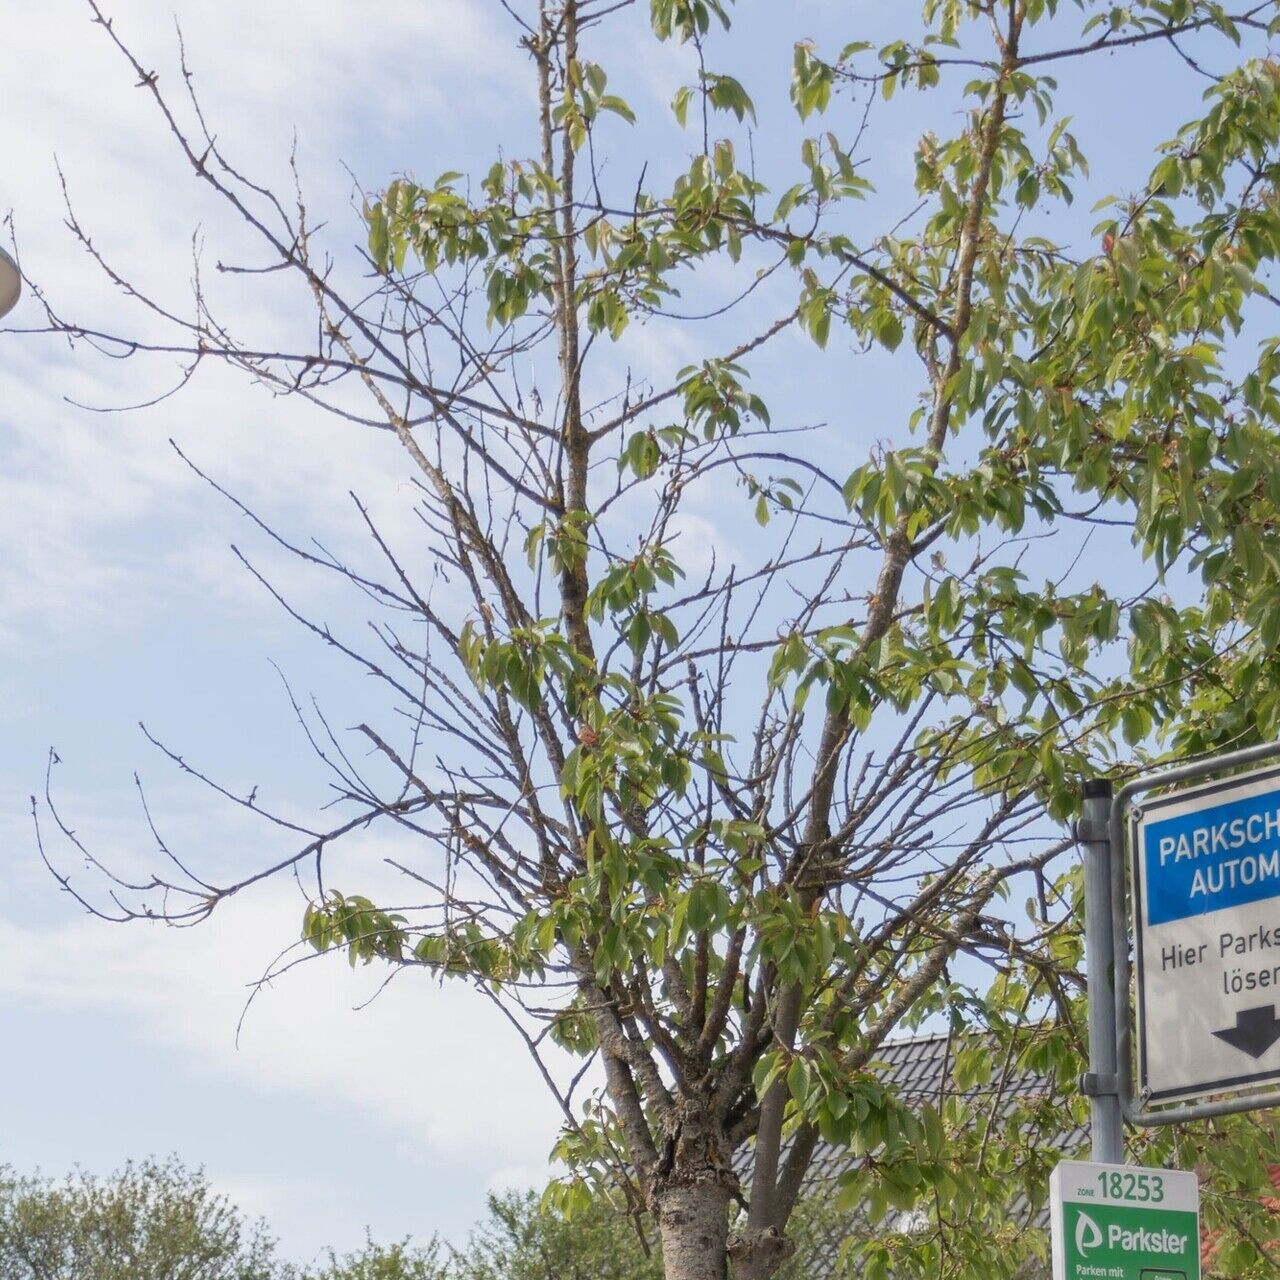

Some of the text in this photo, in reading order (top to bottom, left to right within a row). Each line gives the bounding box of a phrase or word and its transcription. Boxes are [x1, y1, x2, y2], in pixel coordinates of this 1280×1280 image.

[1161, 943, 1207, 971] Hier
[1077, 1171, 1164, 1203] ZONE 18253
[1107, 1224, 1188, 1255] Parkster
[1076, 1264, 1124, 1278] Parken mit
